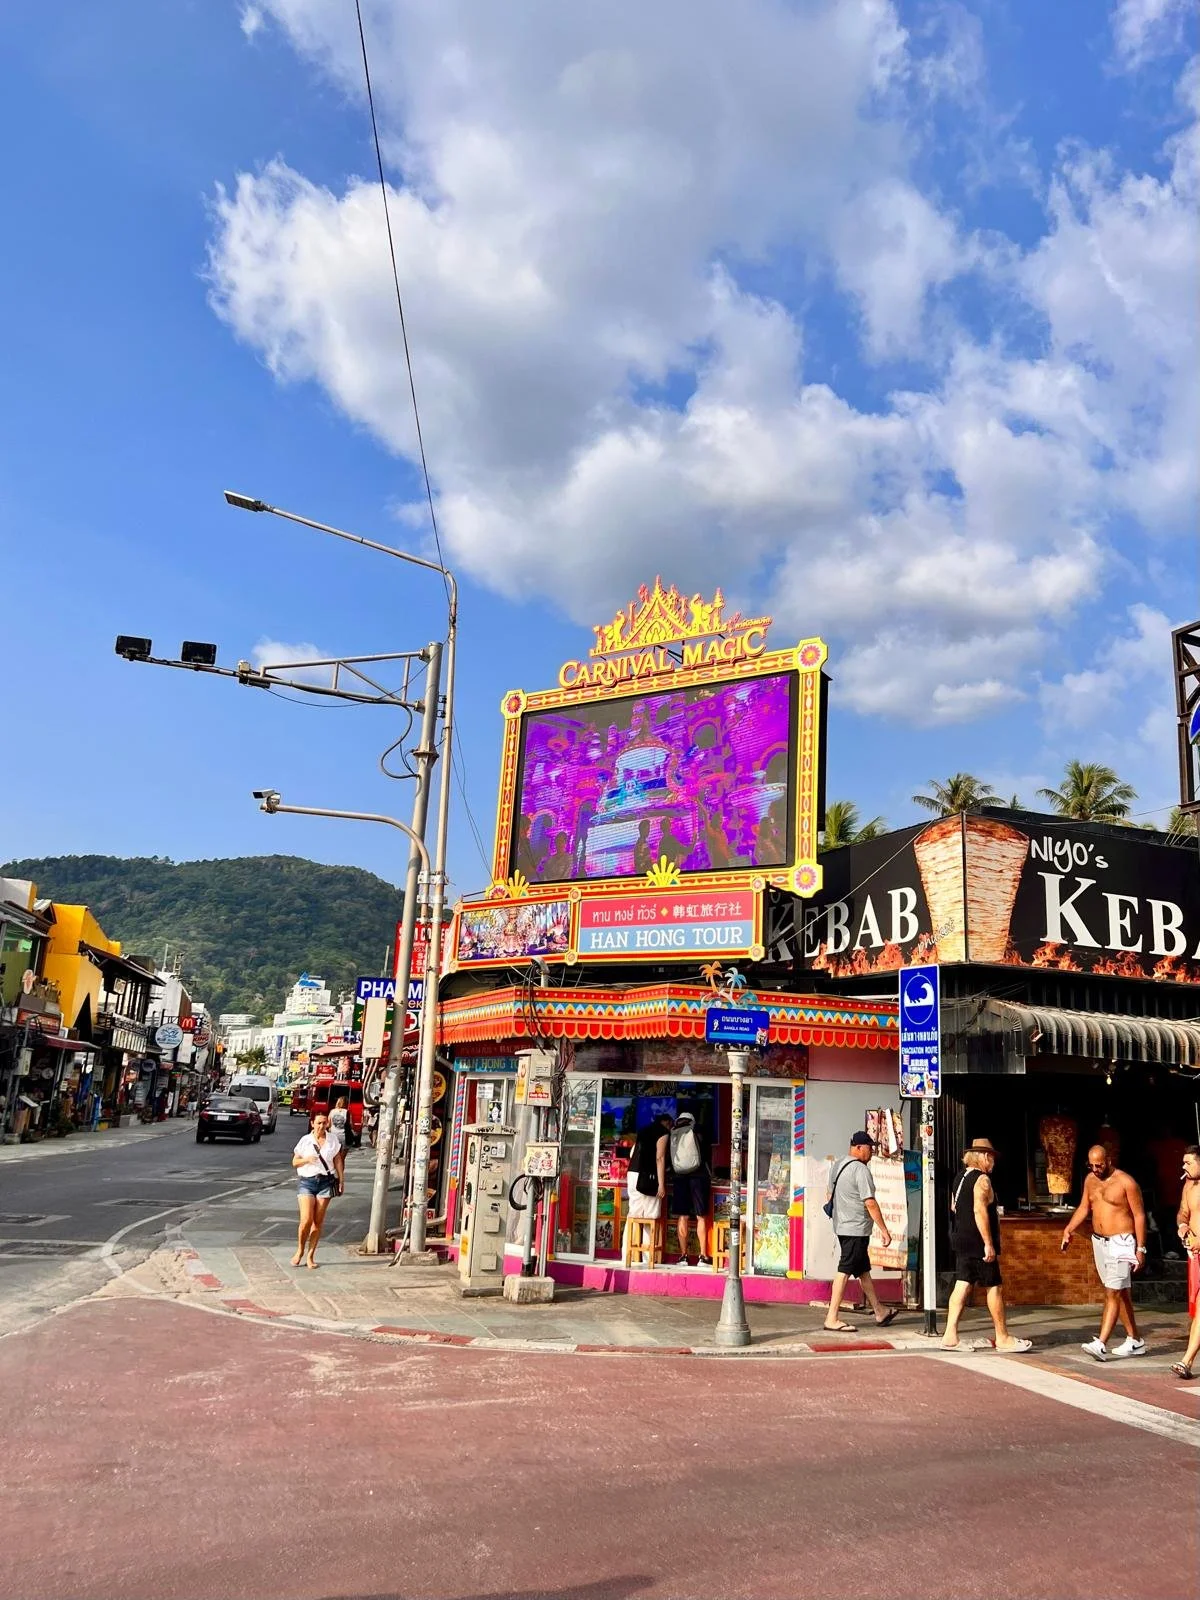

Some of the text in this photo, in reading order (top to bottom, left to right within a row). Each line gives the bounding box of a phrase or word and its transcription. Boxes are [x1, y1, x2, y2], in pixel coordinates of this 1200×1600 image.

[559, 627, 768, 688] CARNIVAL MAGIC
[637, 903, 657, 921] ทัวร์
[672, 902, 743, 918] 韩虹旅行社
[1037, 871, 1200, 960] KEB
[760, 886, 919, 964] KEBAB
[590, 926, 743, 950] HAN HONG TOUR
[925, 1045, 938, 1053] ROUTE
